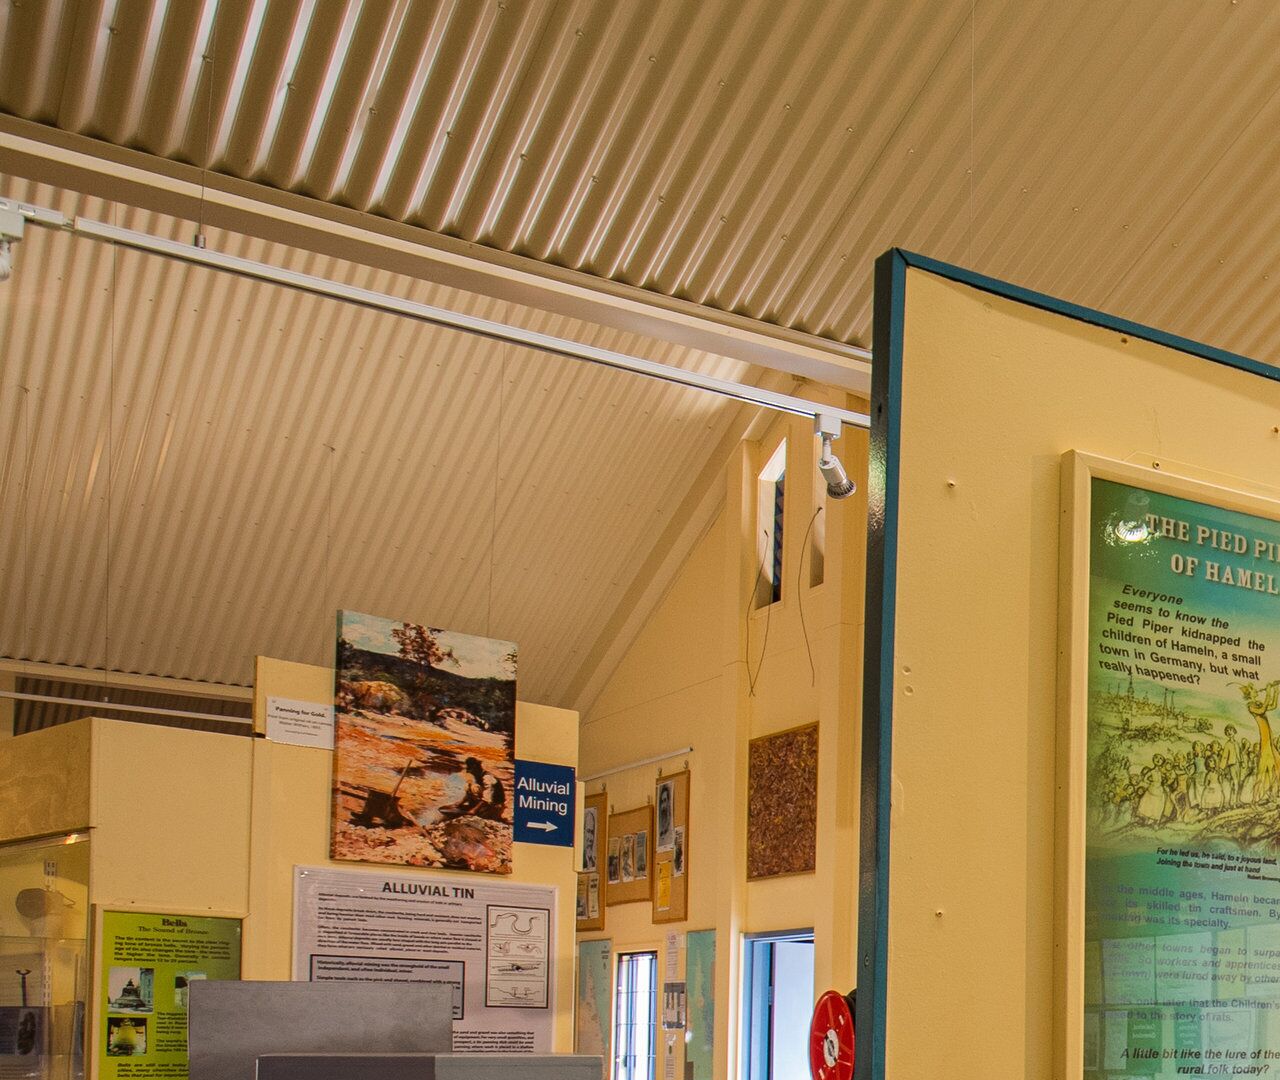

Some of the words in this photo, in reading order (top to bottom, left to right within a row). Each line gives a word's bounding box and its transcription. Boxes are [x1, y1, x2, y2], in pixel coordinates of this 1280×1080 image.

[1146, 513, 1189, 542] THE
[1196, 525, 1247, 555] PIED
[1170, 553, 1198, 577] OF
[1122, 583, 1183, 606] Everyone
[1113, 599, 1152, 615] seems
[1158, 605, 1169, 618] to
[1175, 609, 1206, 625] know
[1211, 616, 1229, 629] the
[1106, 611, 1133, 627] Pied
[1142, 618, 1173, 634] Piper
[1181, 625, 1240, 647] kidnapped
[1248, 638, 1265, 651] the
[1102, 627, 1150, 645] children
[1155, 637, 1168, 649] of
[1171, 638, 1217, 659] Hameln,
[1221, 650, 1227, 659] a
[1231, 652, 1261, 665] small
[1098, 659, 1131, 676] really
[1135, 663, 1200, 685] happened?
[1099, 642, 1129, 657] town
[1134, 648, 1145, 660] in
[1150, 651, 1205, 672] Germany,
[1210, 661, 1228, 675] but
[1232, 666, 1259, 680] what
[275, 706, 300, 715] Panning
[518, 777, 570, 796] Alluvial
[519, 795, 567, 816] Mining
[382, 882, 449, 897] ALLUVIAL
[452, 887, 475, 899] TIN
[162, 918, 188, 927] Bells
[1120, 1048, 1129, 1059] A
[1133, 1048, 1158, 1059] little
[1162, 1048, 1177, 1059] bit
[1180, 1048, 1201, 1059] like
[1205, 1048, 1222, 1059] the
[1225, 1048, 1246, 1059] lure
[1250, 1048, 1262, 1059] of
[1264, 1048, 1280, 1059] the
[1177, 1063, 1203, 1074] rural
[1206, 1063, 1228, 1074] folk
[1232, 1063, 1269, 1077] today?
